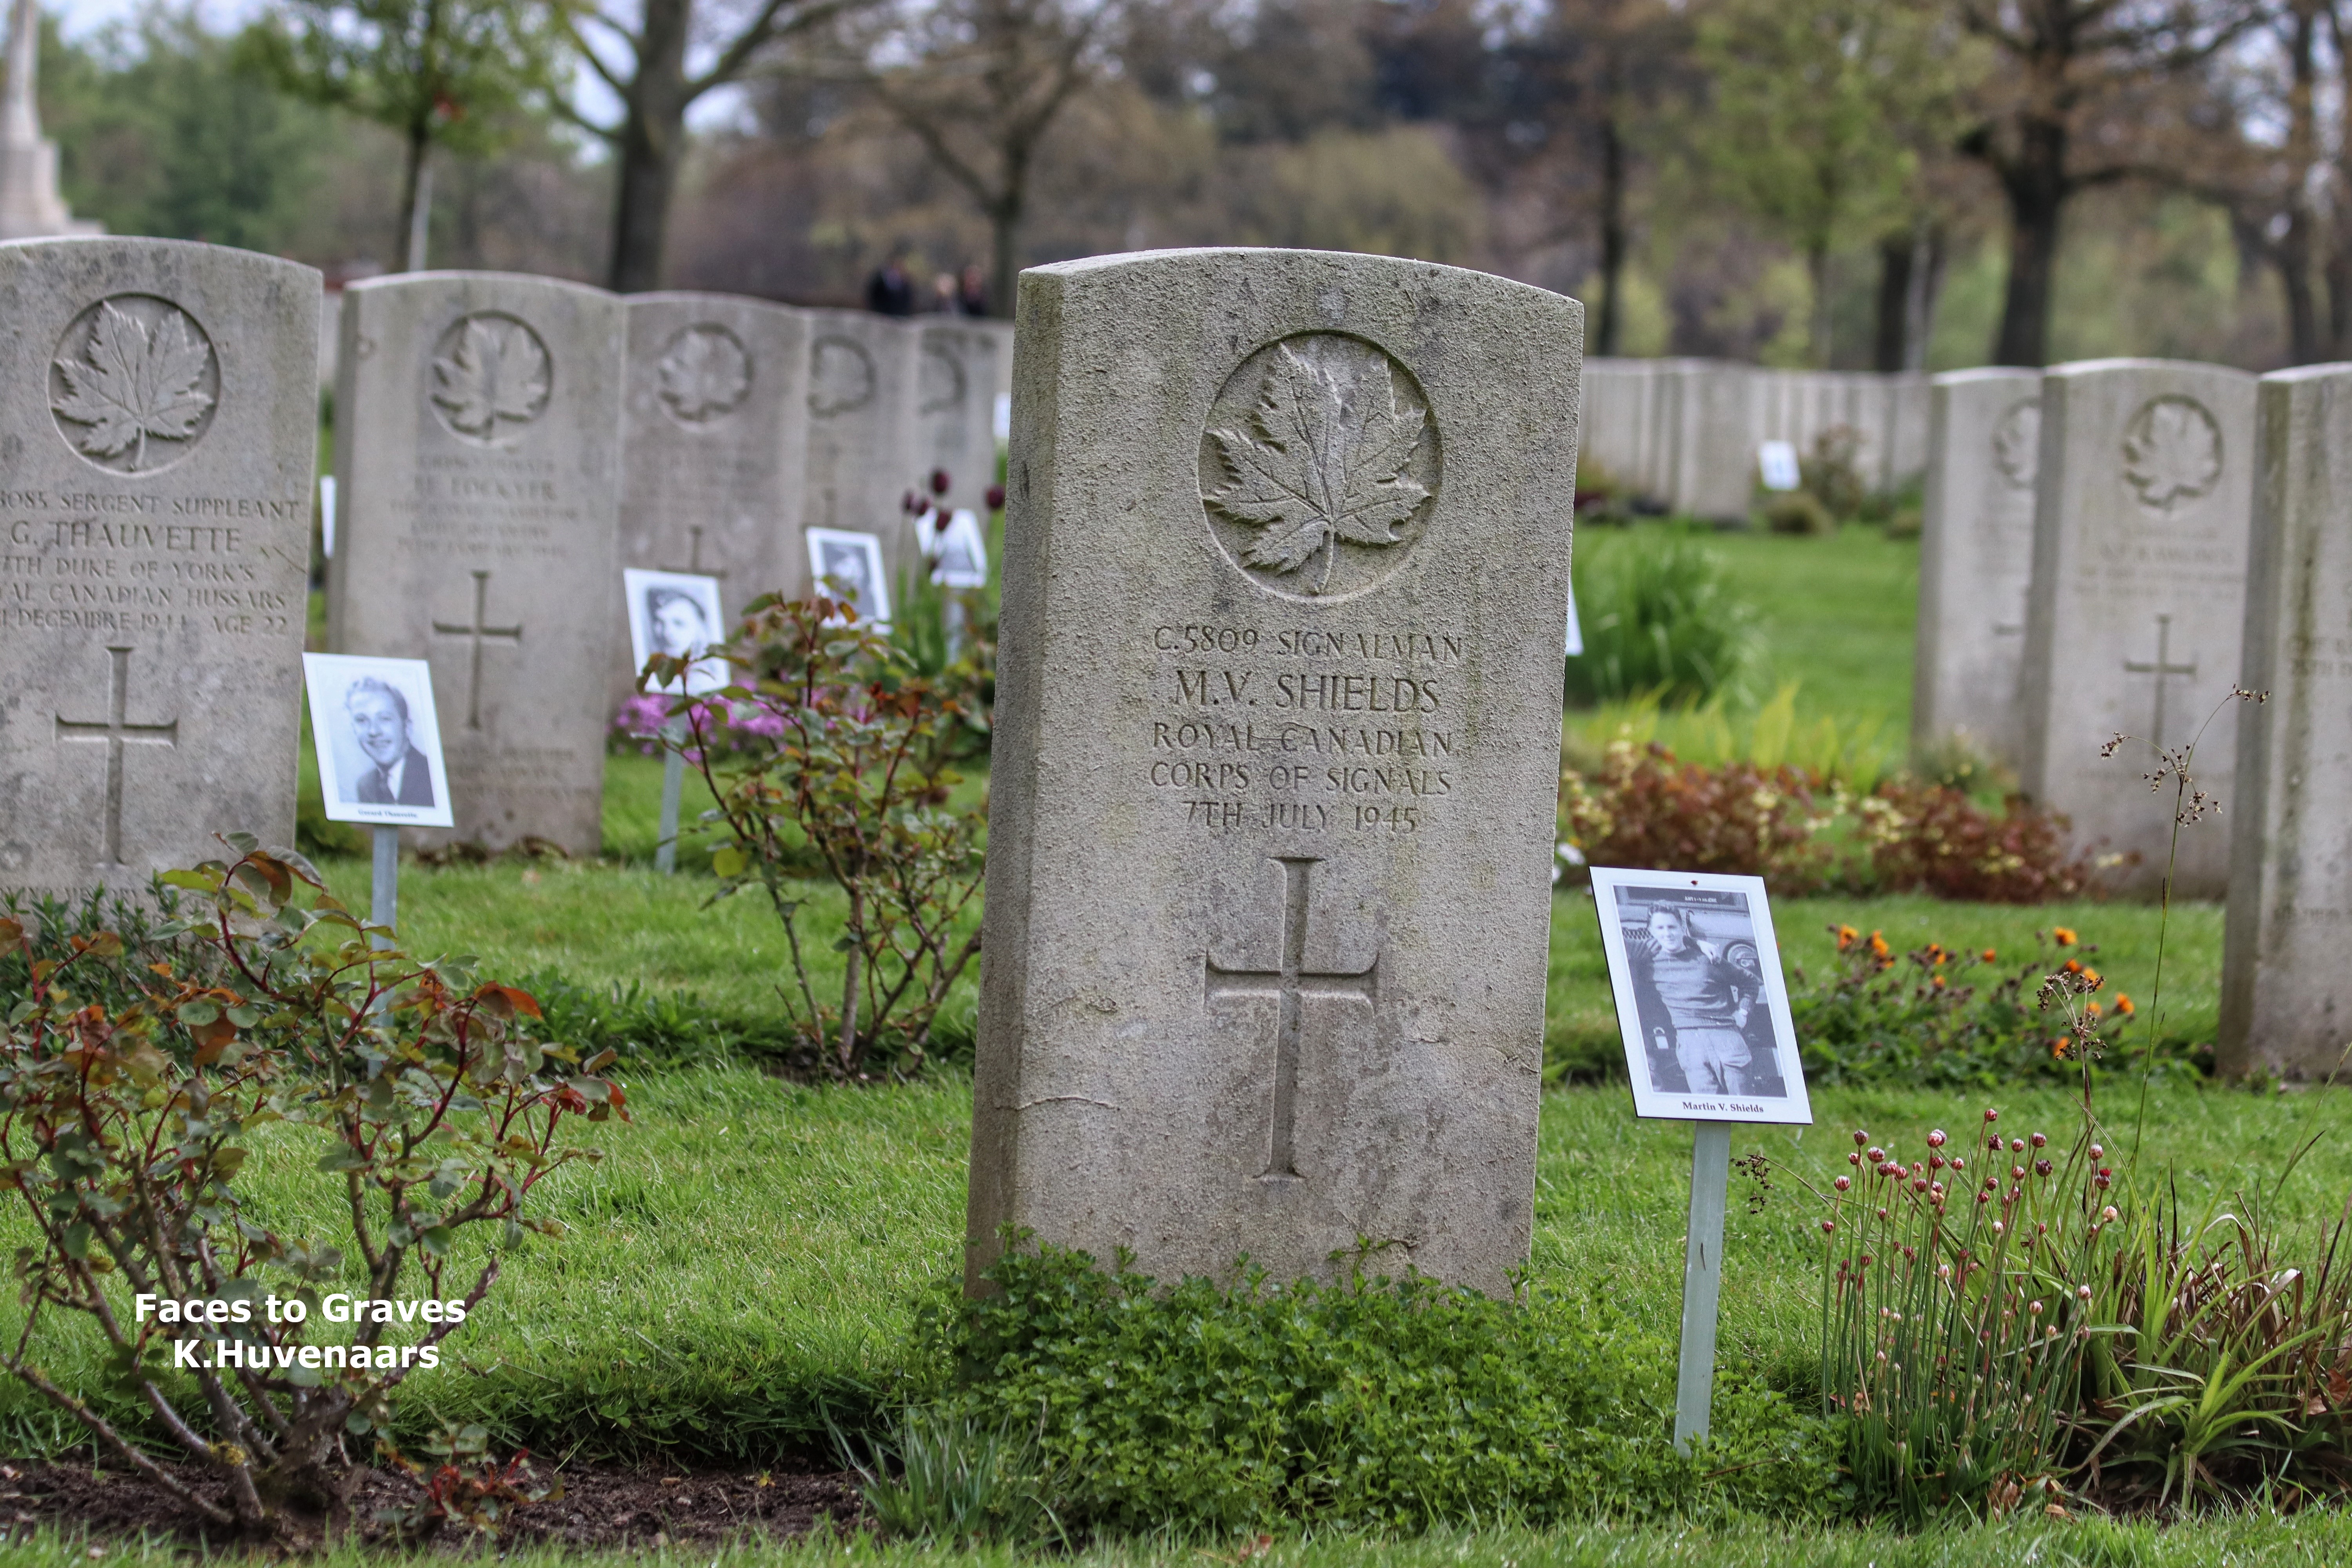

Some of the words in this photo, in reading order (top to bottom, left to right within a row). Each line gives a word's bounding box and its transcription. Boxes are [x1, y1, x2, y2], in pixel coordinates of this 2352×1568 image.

[61, 492, 160, 513] SERGENT
[172, 497, 299, 521] SUPPLEANT
[11, 520, 39, 546] G.
[48, 521, 241, 552] THAUVETTE
[56, 557, 117, 578] DUKE
[129, 561, 158, 581] OF
[171, 561, 255, 582] YORK'S
[49, 583, 171, 606] CANADIAN
[187, 588, 285, 610] HUSSARS
[18, 609, 131, 630] DECEMBRE
[263, 615, 288, 634] 22
[1154, 626, 1258, 653] C.5809
[1277, 630, 1462, 661] SIGNALMAN
[1176, 670, 1254, 706] M.V.
[1276, 674, 1440, 713] SHIELDS
[1154, 722, 1259, 750] ROYAL
[1281, 727, 1452, 757] CANADIAN
[1151, 761, 1249, 789] CORPS
[1269, 766, 1308, 790] OF
[1326, 767, 1451, 795] SIGNALS
[1178, 800, 1242, 826] 7TH
[1262, 804, 1335, 830] JULY
[1355, 806, 1419, 833] 1945
[1682, 1102, 1716, 1111] Martin
[1718, 1103, 1728, 1111] V.
[1730, 1103, 1764, 1113] Shields
